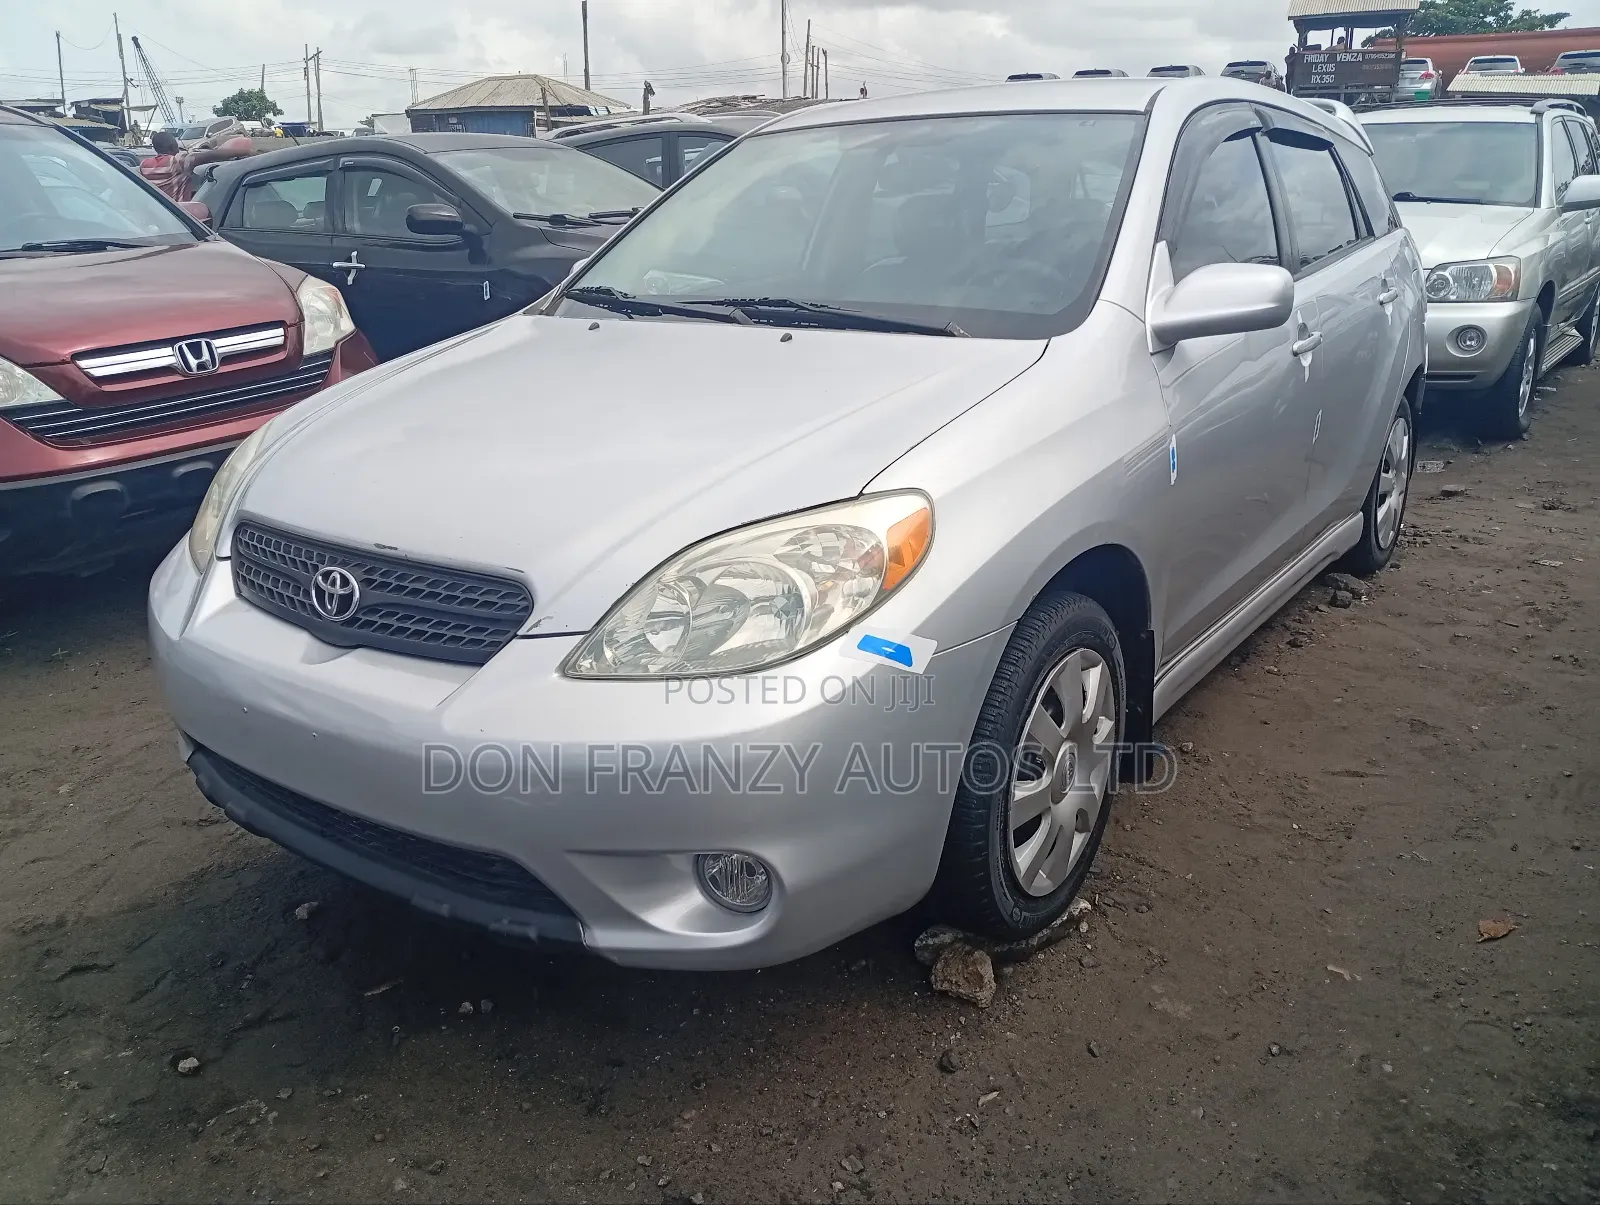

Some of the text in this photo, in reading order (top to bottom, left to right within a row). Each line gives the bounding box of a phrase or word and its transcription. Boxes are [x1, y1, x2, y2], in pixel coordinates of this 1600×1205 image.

[1304, 53, 1329, 63] FRIDAY
[1337, 52, 1362, 62] VENZA
[1312, 64, 1336, 73] LEXUS
